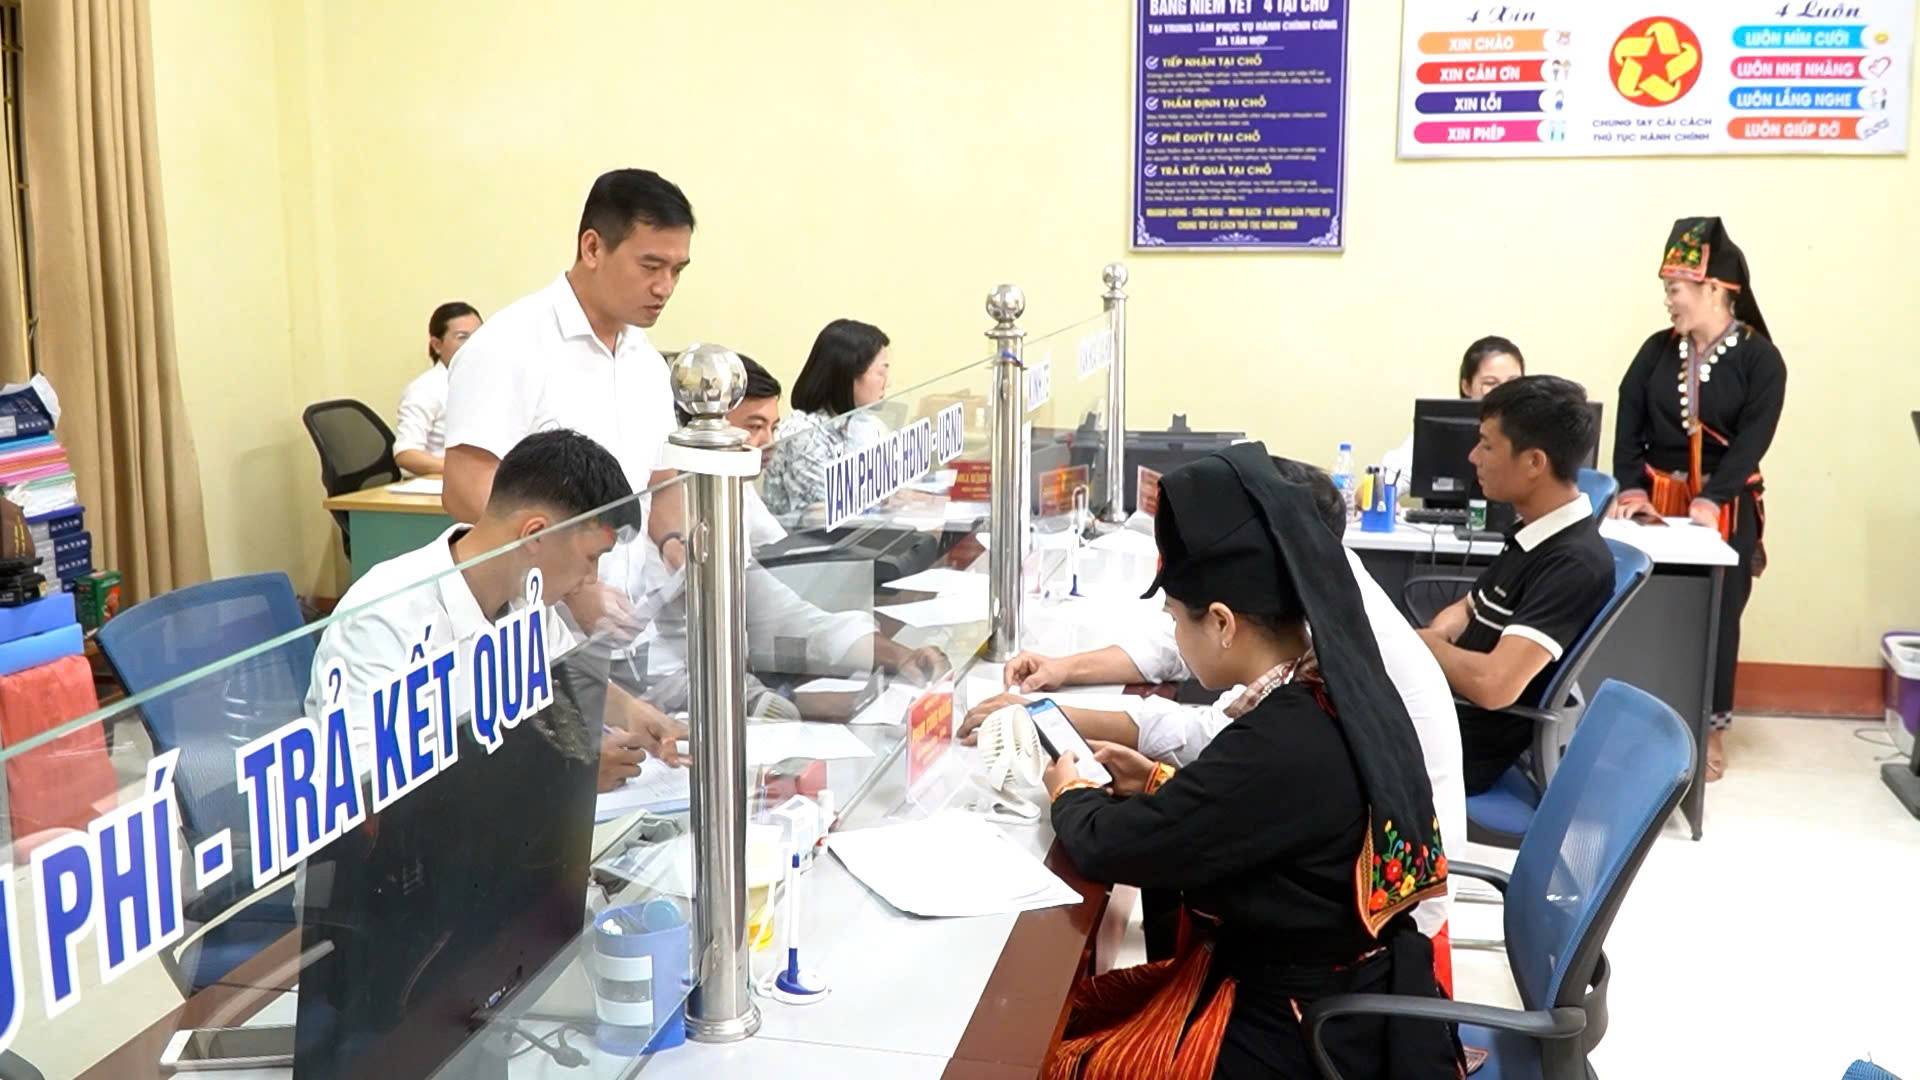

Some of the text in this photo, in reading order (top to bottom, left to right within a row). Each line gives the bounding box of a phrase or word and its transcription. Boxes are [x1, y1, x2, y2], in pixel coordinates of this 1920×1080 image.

[1488, 6, 1536, 23] Xin
[1776, 0, 1861, 18] 4 Luôn
[1148, 18, 1339, 35] TẠI TRUNG TÂM PHỤC VỤ HÀNH CHÍNH CÔNG
[1230, 35, 1248, 46] TÂN
[1449, 33, 1515, 51] XIN CHÀO
[1745, 29, 1781, 47] LUÔN
[1162, 53, 1263, 69] TIẾP NHẬN TẠI CHỖ
[1737, 59, 1855, 80] LUÔN NHẸ NHÀNG
[1439, 63, 1521, 81] XIN CẢM ƠN
[1193, 98, 1221, 111] ĐỊNH
[1223, 98, 1240, 110] TẠI
[1241, 94, 1267, 108] CHỖ
[1454, 92, 1502, 111] XIN LỖI
[1737, 87, 1852, 107] LUÔN LẮNG NGHE
[1592, 116, 1713, 128] CHUNG TAY CẢI CÁCH
[1744, 120, 1781, 138] LUÔN
[1783, 120, 1817, 137] GIÚP
[1161, 129, 1262, 145] PHÊ DUYỆT TẠI CHỖ
[1447, 125, 1507, 142] XIN PHÉP
[1593, 131, 1710, 143] THỦ TỤC HÀNH CHÍNH
[1160, 162, 1273, 178] TRẢ KẾT QUẢ TẠI CHỖ
[826, 452, 855, 527] VĂN
[858, 430, 899, 509] PHÒNG
[902, 422, 930, 483] HĐND
[939, 407, 963, 461] UBND
[42, 767, 177, 1003] PHÍ
[243, 666, 360, 875] TRẢ
[371, 623, 456, 803] KẾT
[473, 575, 549, 744] QUẢ
